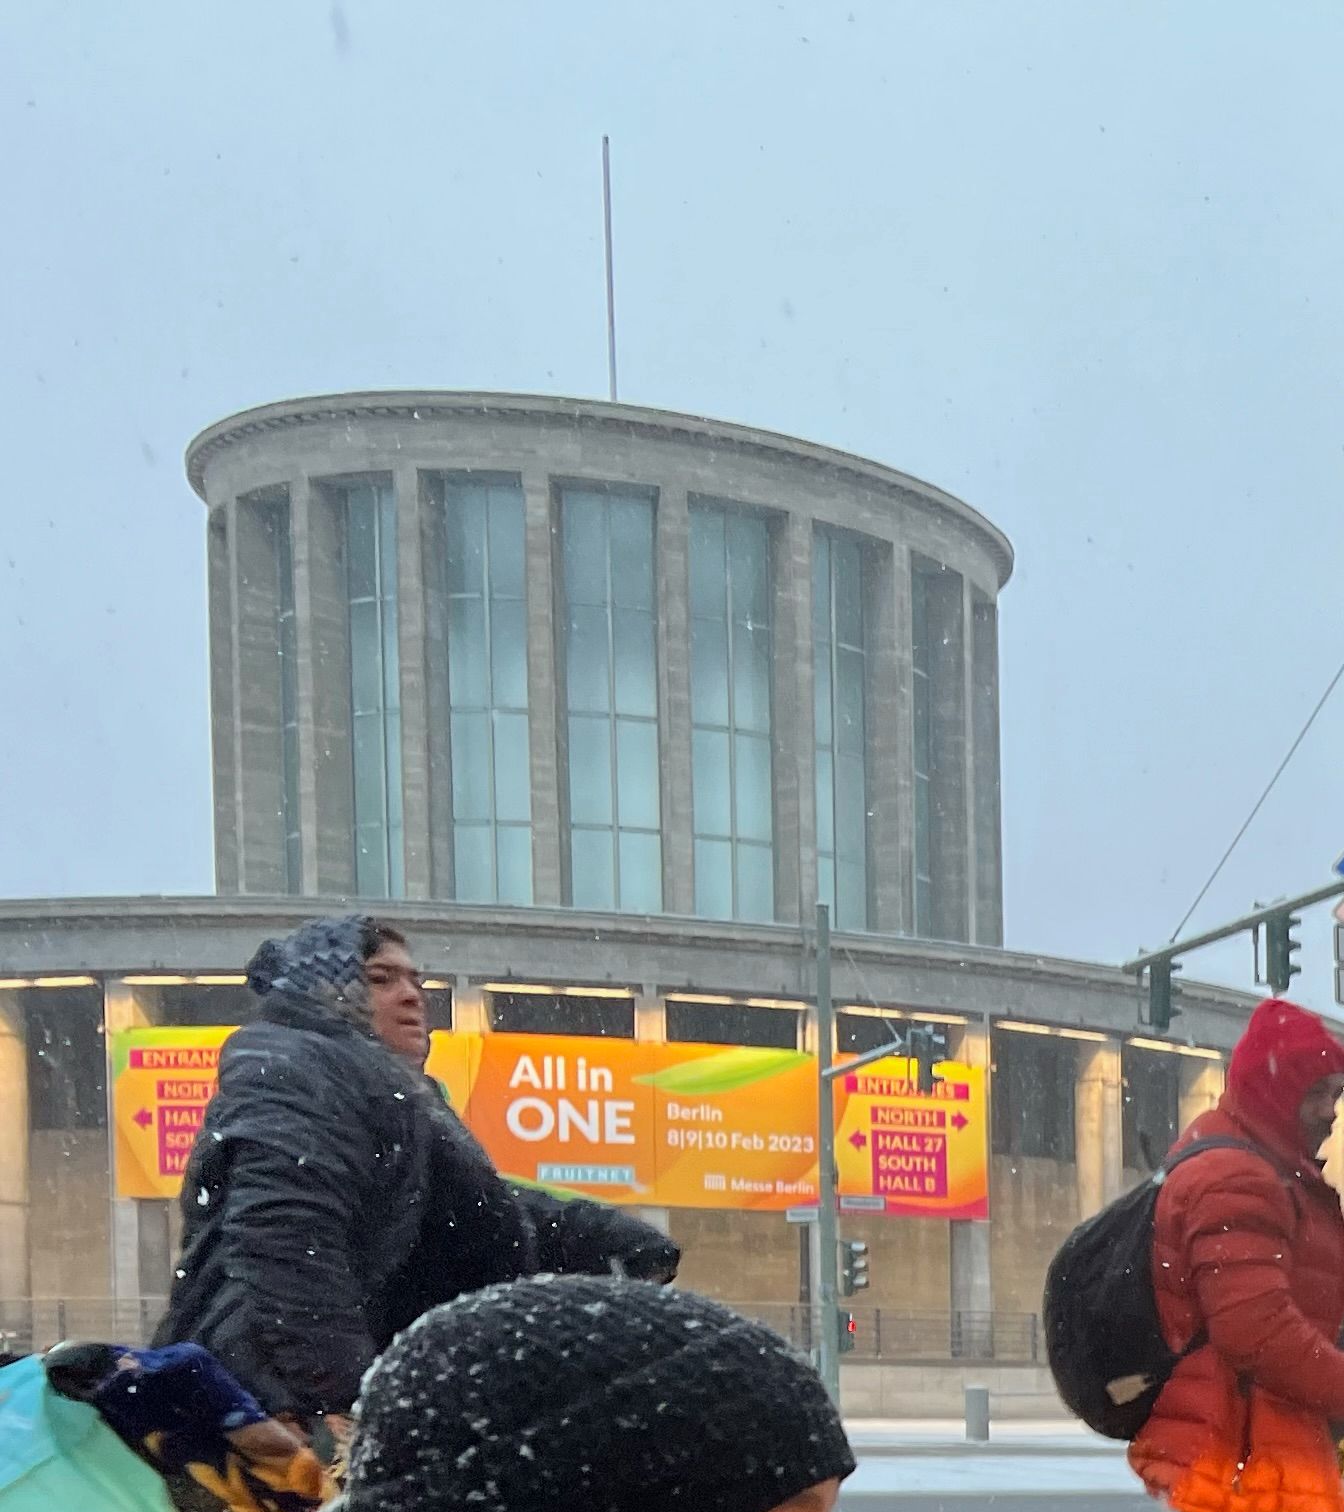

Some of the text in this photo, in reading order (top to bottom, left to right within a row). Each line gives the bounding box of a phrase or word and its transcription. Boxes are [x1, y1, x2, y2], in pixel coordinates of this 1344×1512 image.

[142, 1050, 217, 1067] ENTRAN
[510, 1055, 613, 1092] All in
[506, 1097, 636, 1144] ONE
[667, 1102, 723, 1123] Berlin
[877, 1109, 938, 1125] NORTH
[731, 1133, 764, 1150] Feb
[768, 1135, 814, 1153] 2023
[878, 1135, 942, 1153] HALL 27
[878, 1155, 936, 1172] SOUTH
[731, 1177, 814, 1195] Messe Berlin
[879, 1175, 920, 1191] HALL
